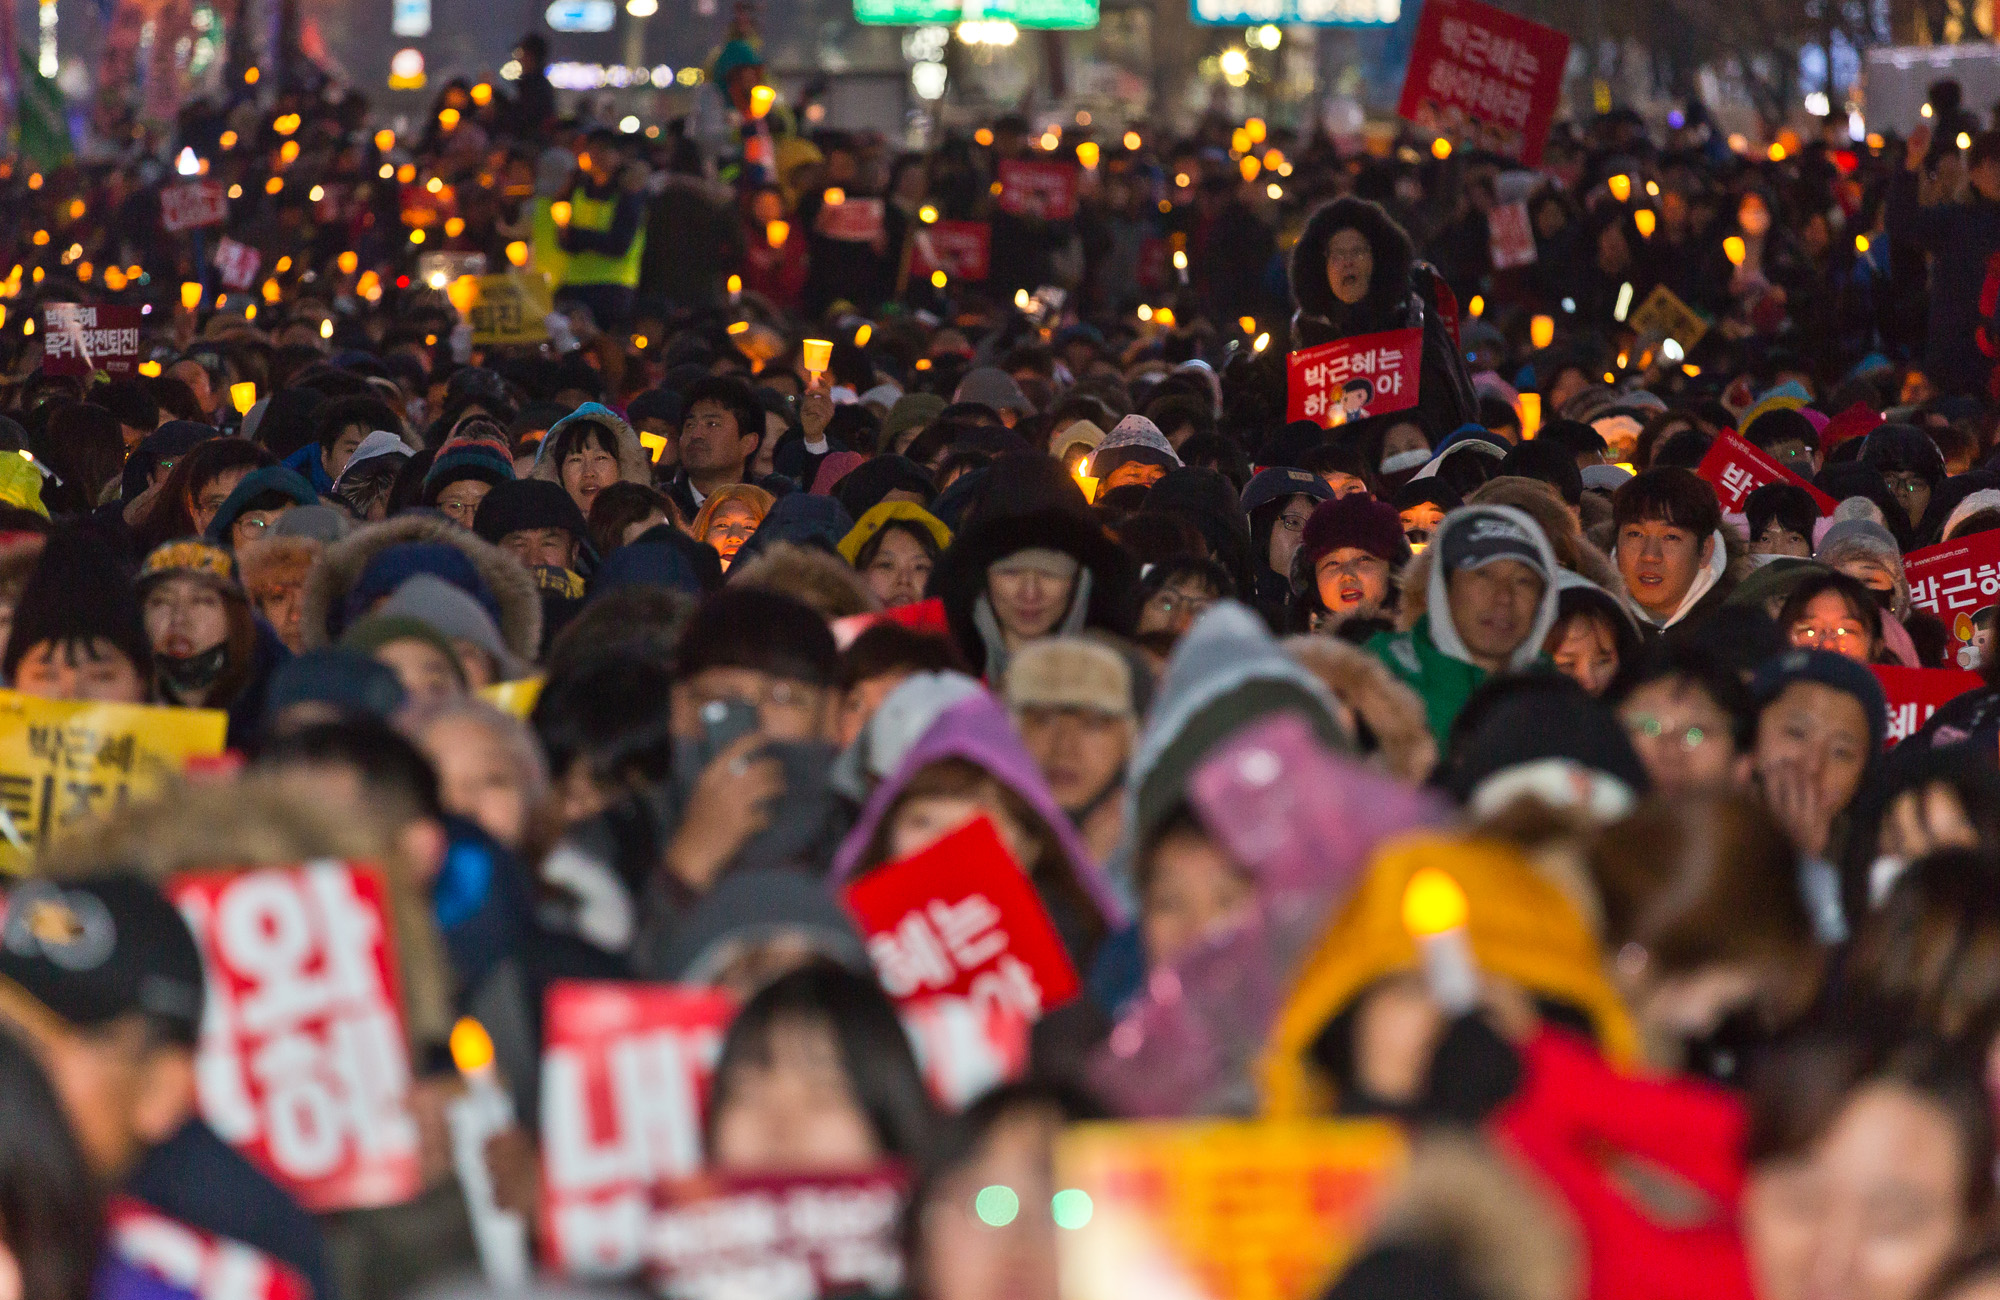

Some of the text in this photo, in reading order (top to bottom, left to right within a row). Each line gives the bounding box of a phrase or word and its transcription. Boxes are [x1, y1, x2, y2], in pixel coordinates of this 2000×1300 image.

[1438, 16, 1540, 85] 박근혜는
[44, 306, 97, 329] 박혜
[1304, 346, 1404, 388] 박근혜는
[1720, 461, 1766, 503] 박
[1913, 546, 1970, 567] www.nanum.com
